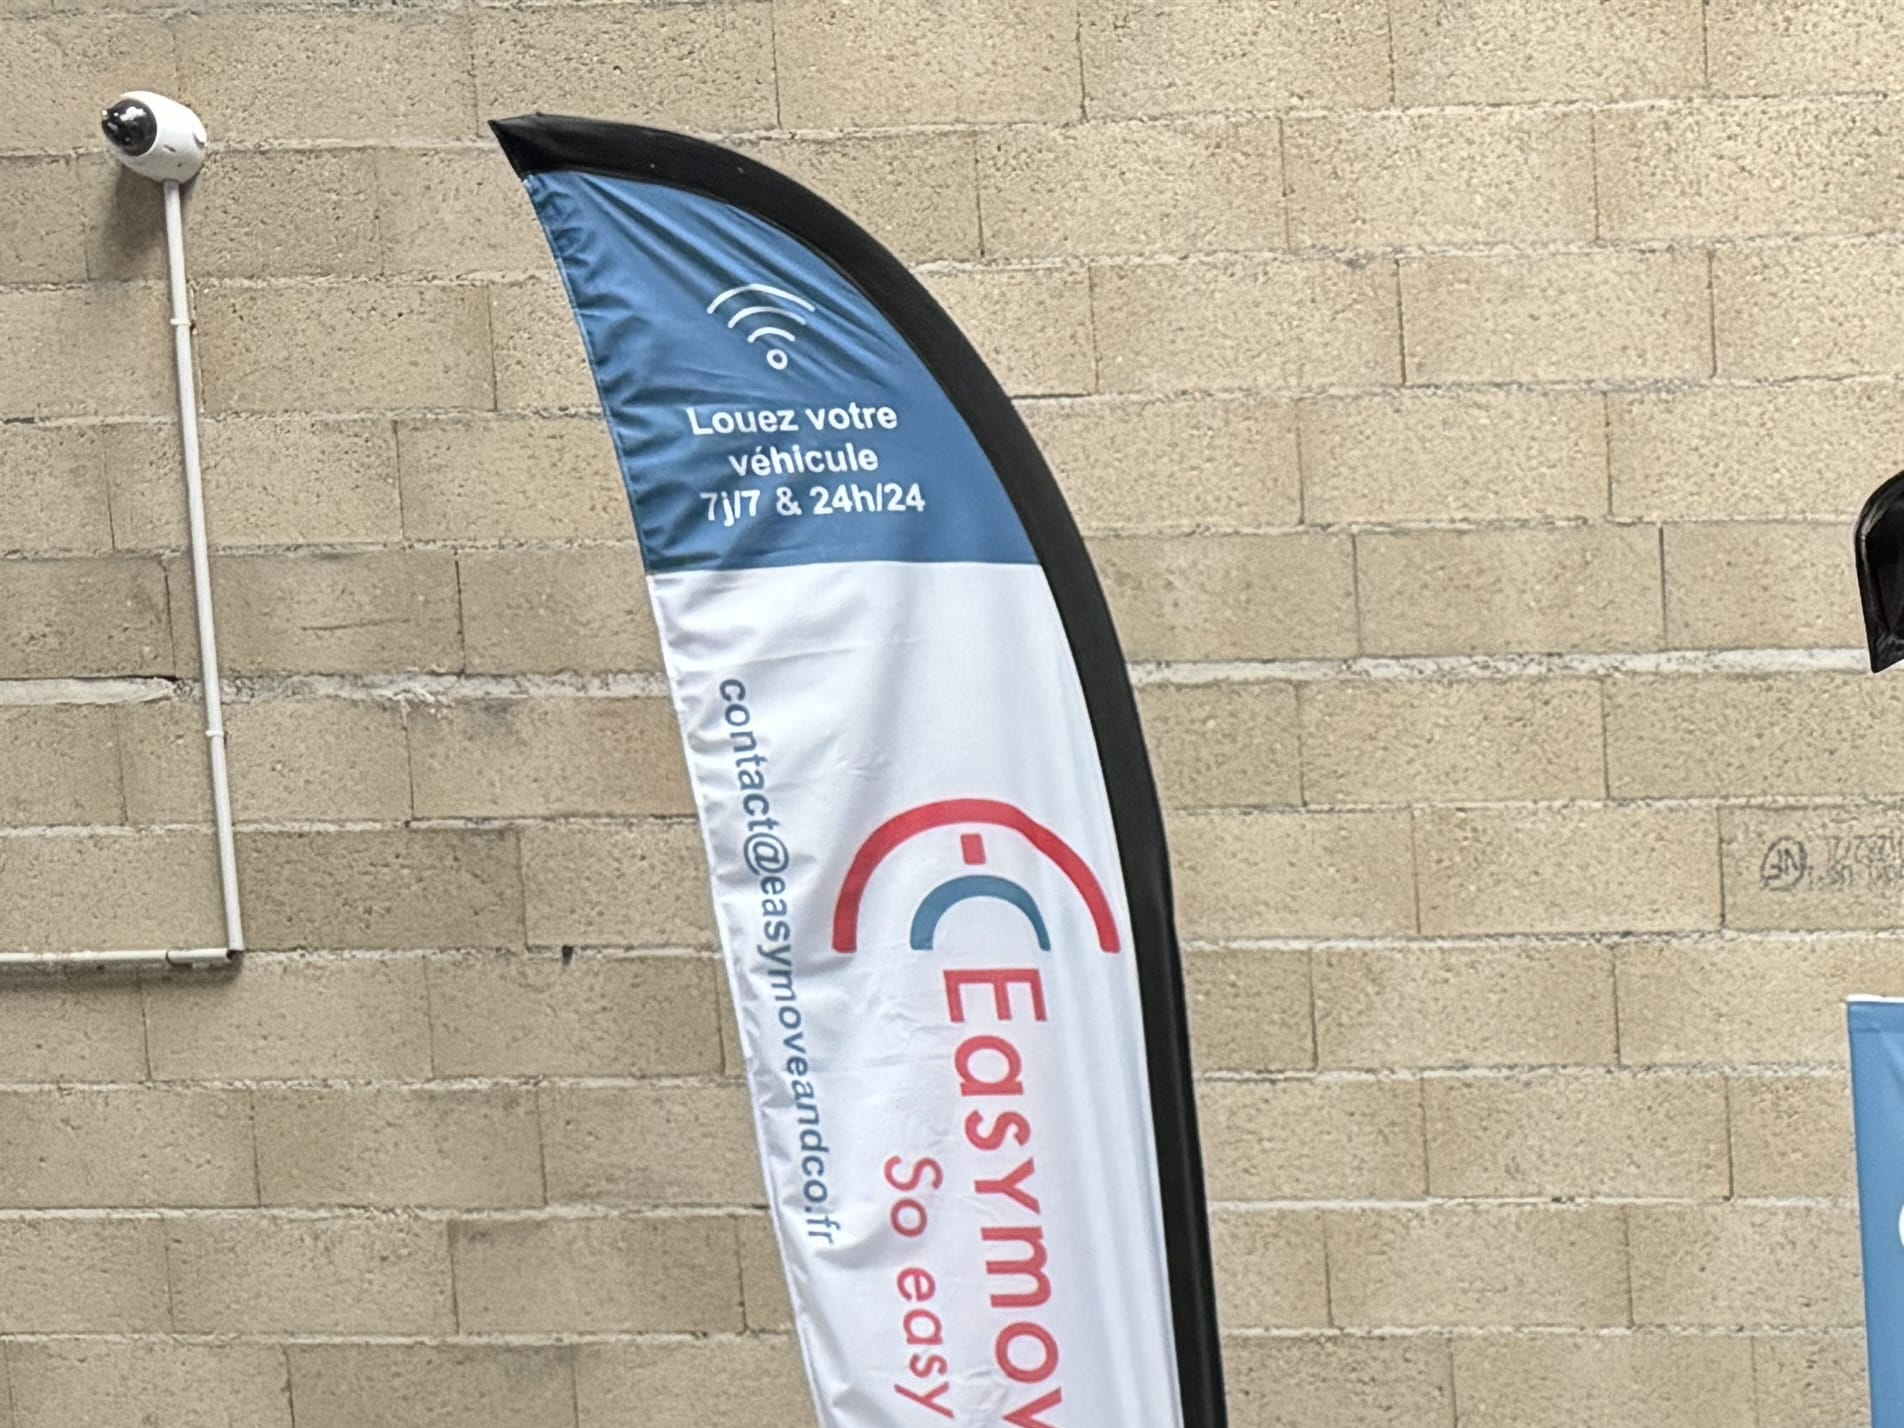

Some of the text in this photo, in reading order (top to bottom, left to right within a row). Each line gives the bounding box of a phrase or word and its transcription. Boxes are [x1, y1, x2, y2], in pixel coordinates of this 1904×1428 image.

[683, 402, 898, 436] Louez votre
[728, 442, 879, 477] véhicule
[700, 482, 926, 527] 7j/7 & 24h/24
[719, 677, 835, 1246] contact@easymoveandco.fr
[884, 1156, 944, 1238] So
[895, 1267, 954, 1419] easy
